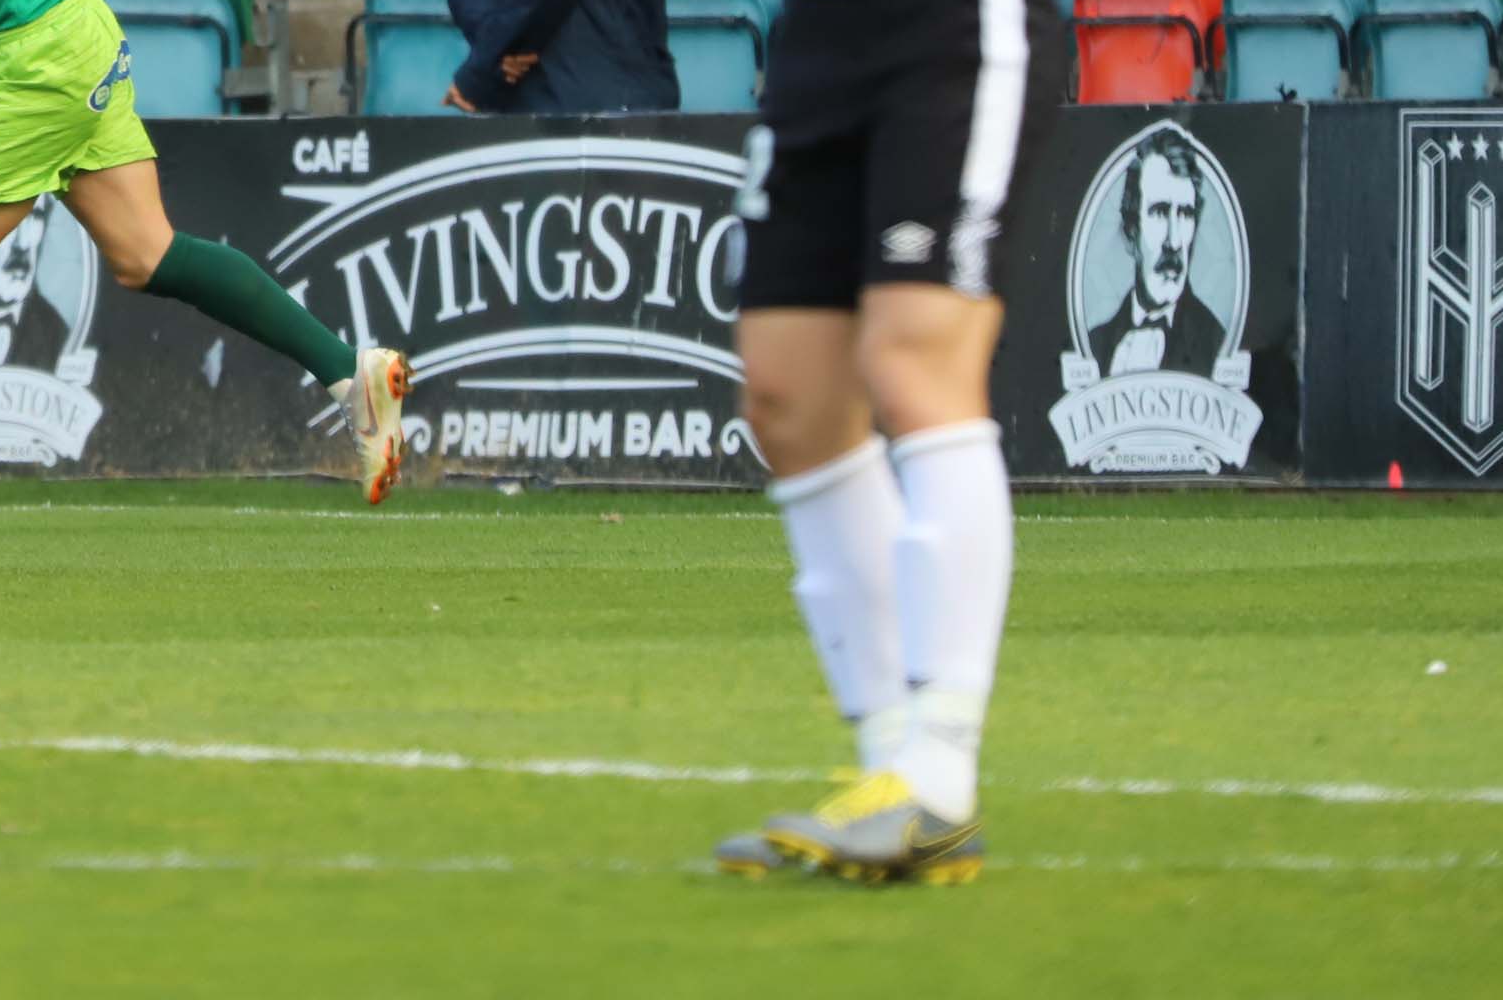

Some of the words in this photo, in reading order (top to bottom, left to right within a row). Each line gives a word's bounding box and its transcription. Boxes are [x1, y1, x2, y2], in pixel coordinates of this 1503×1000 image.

[292, 130, 370, 174] CAFÉ
[286, 194, 742, 388] IVINGSTO
[439, 410, 614, 458] PREMIUM
[623, 410, 713, 458] BAR
[1066, 384, 1247, 445] LIVINGSTONE
